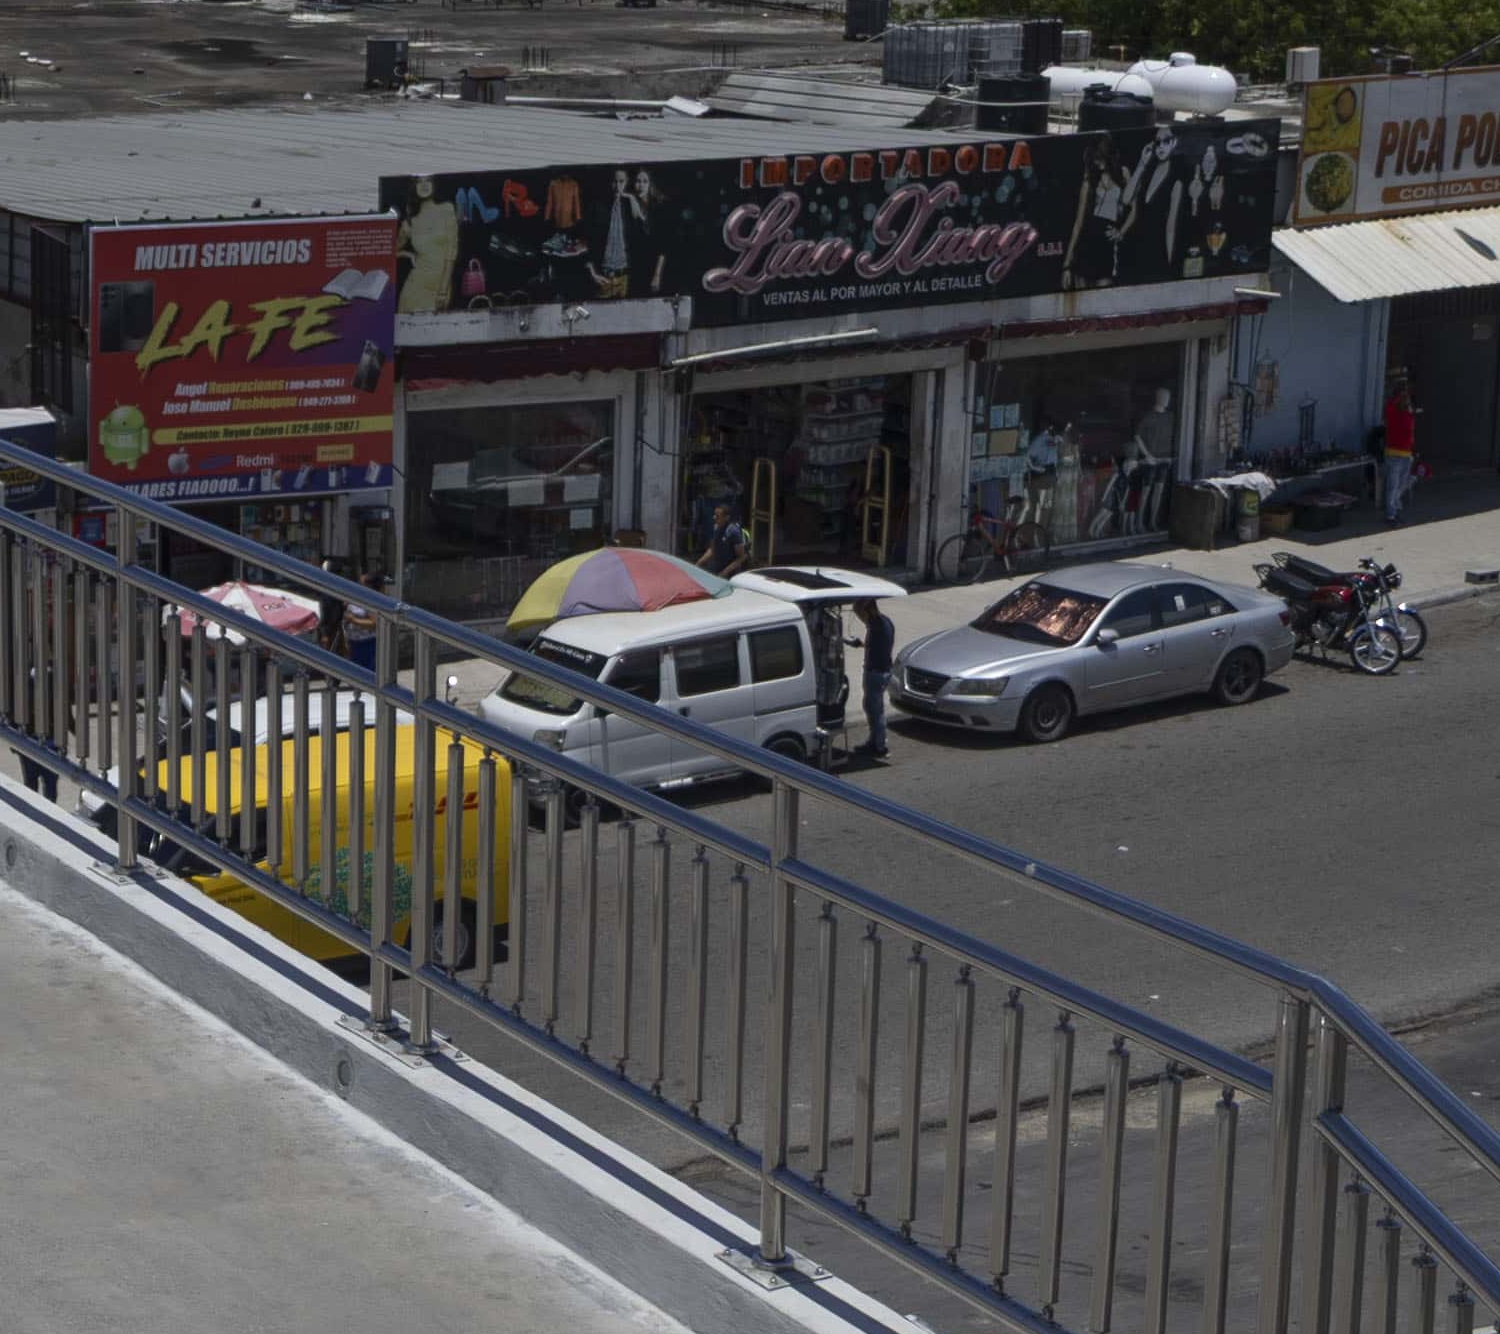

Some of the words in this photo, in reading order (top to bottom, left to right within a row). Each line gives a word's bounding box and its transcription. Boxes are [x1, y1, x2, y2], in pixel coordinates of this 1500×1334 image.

[1374, 116, 1447, 178] PICA
[739, 141, 1034, 189] IMPORTADORA
[1399, 182, 1475, 201] COMIDA
[134, 243, 198, 271] MULTI
[199, 238, 311, 268] SERVICIOS
[702, 191, 854, 294] Lian
[762, 289, 810, 307] VENTAS
[812, 288, 828, 303] AL
[830, 286, 857, 301] POR
[858, 281, 901, 299] MAYOR
[903, 281, 913, 293] Y
[913, 279, 928, 292] AL
[931, 274, 983, 292] DETALLE
[134, 298, 240, 380] LA
[244, 293, 350, 363] FE
[174, 381, 208, 397] Angel
[189, 399, 232, 414] Manuel
[236, 452, 275, 467] Redmi
